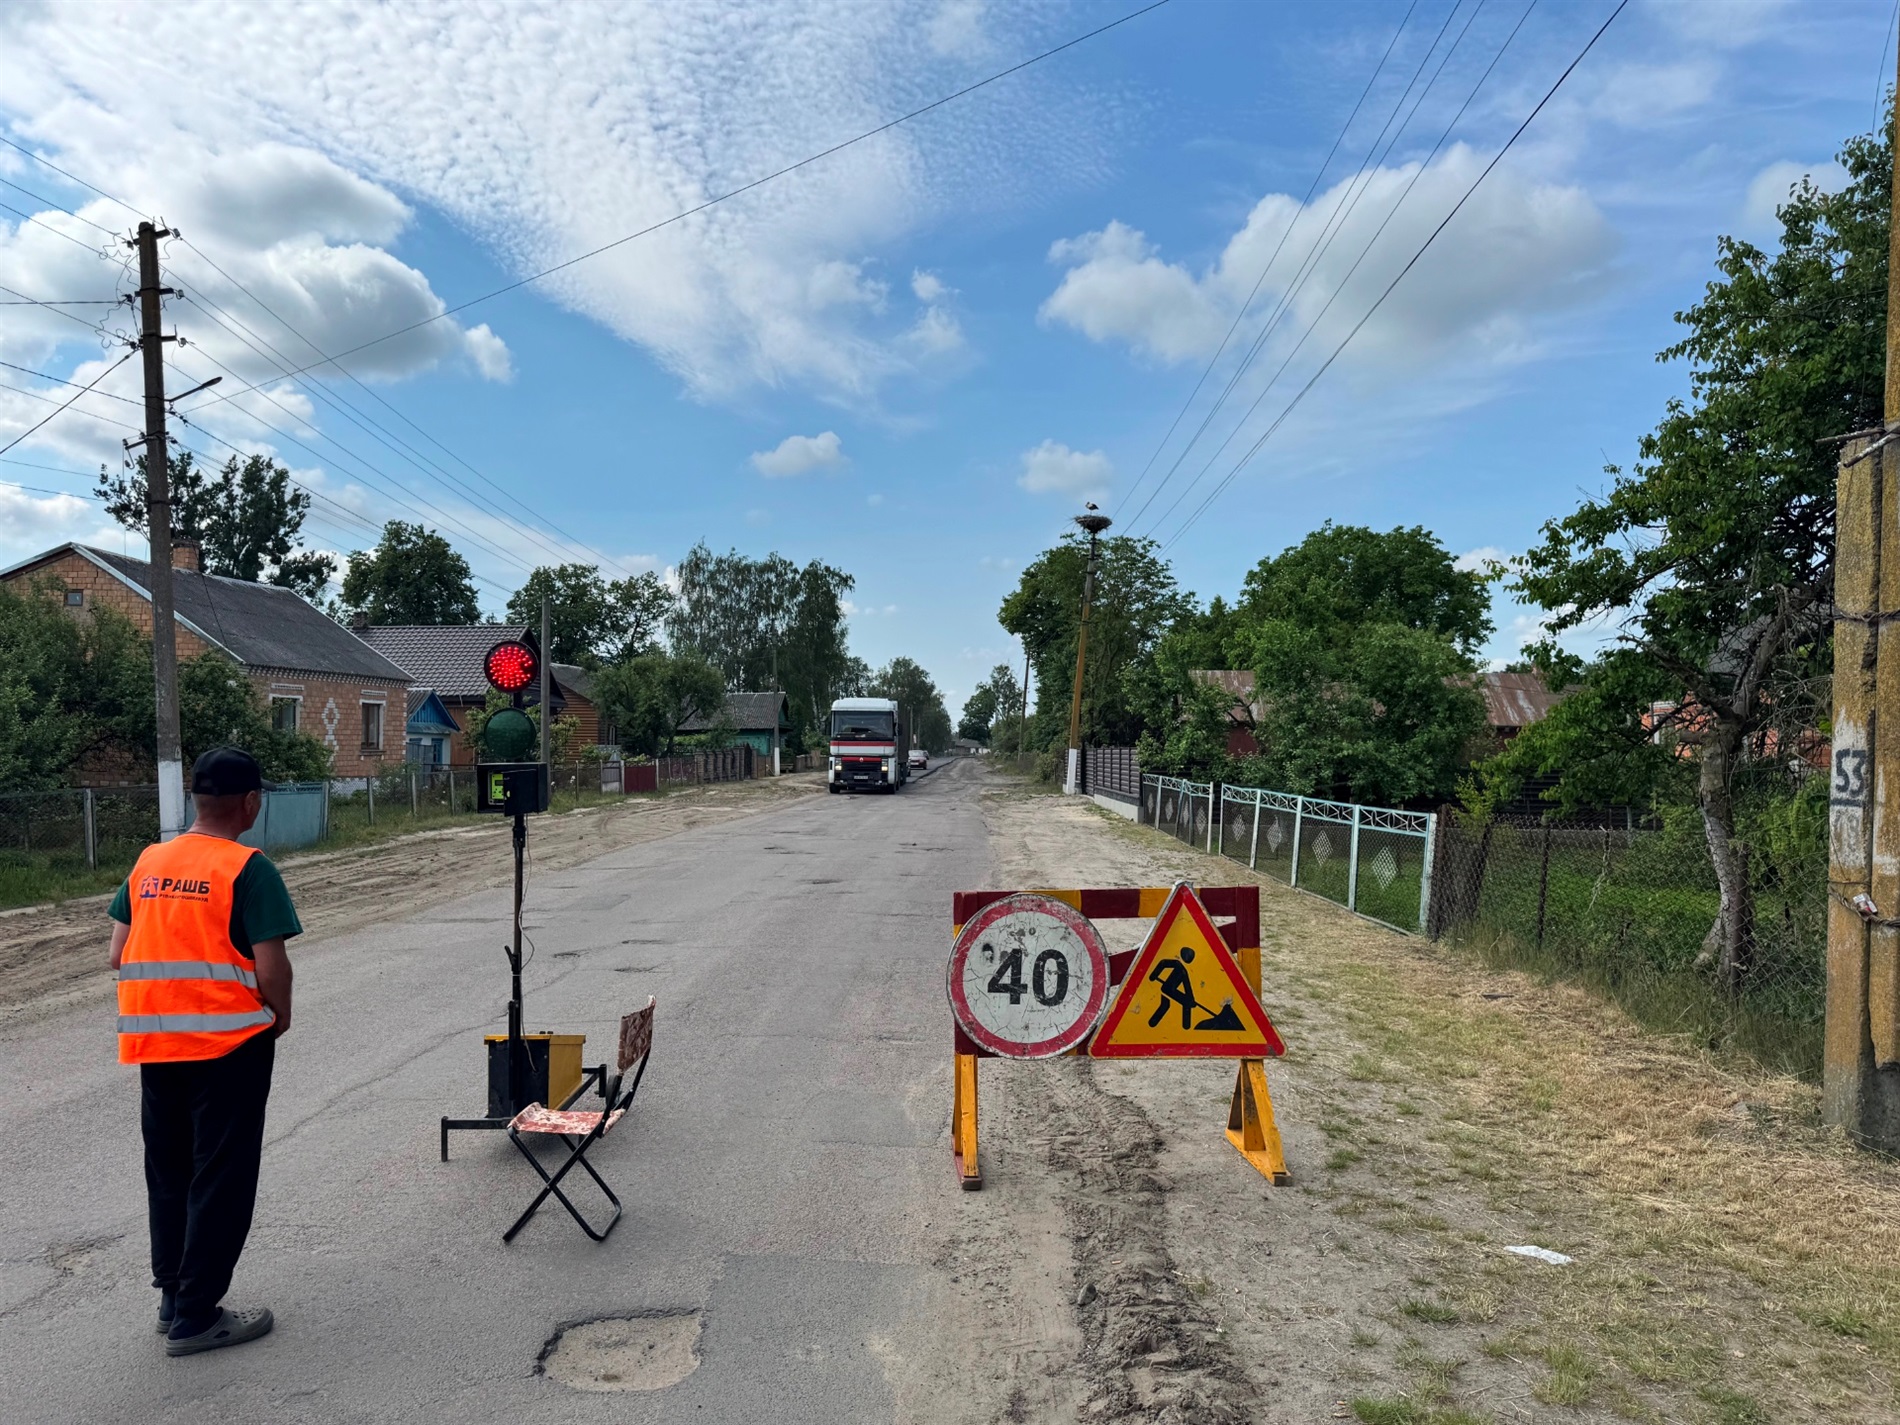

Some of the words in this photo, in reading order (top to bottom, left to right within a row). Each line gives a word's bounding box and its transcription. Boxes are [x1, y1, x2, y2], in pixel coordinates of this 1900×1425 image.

[1835, 748, 1866, 798] 53
[161, 878, 210, 894] РАШБ
[988, 948, 1069, 1007] 40
